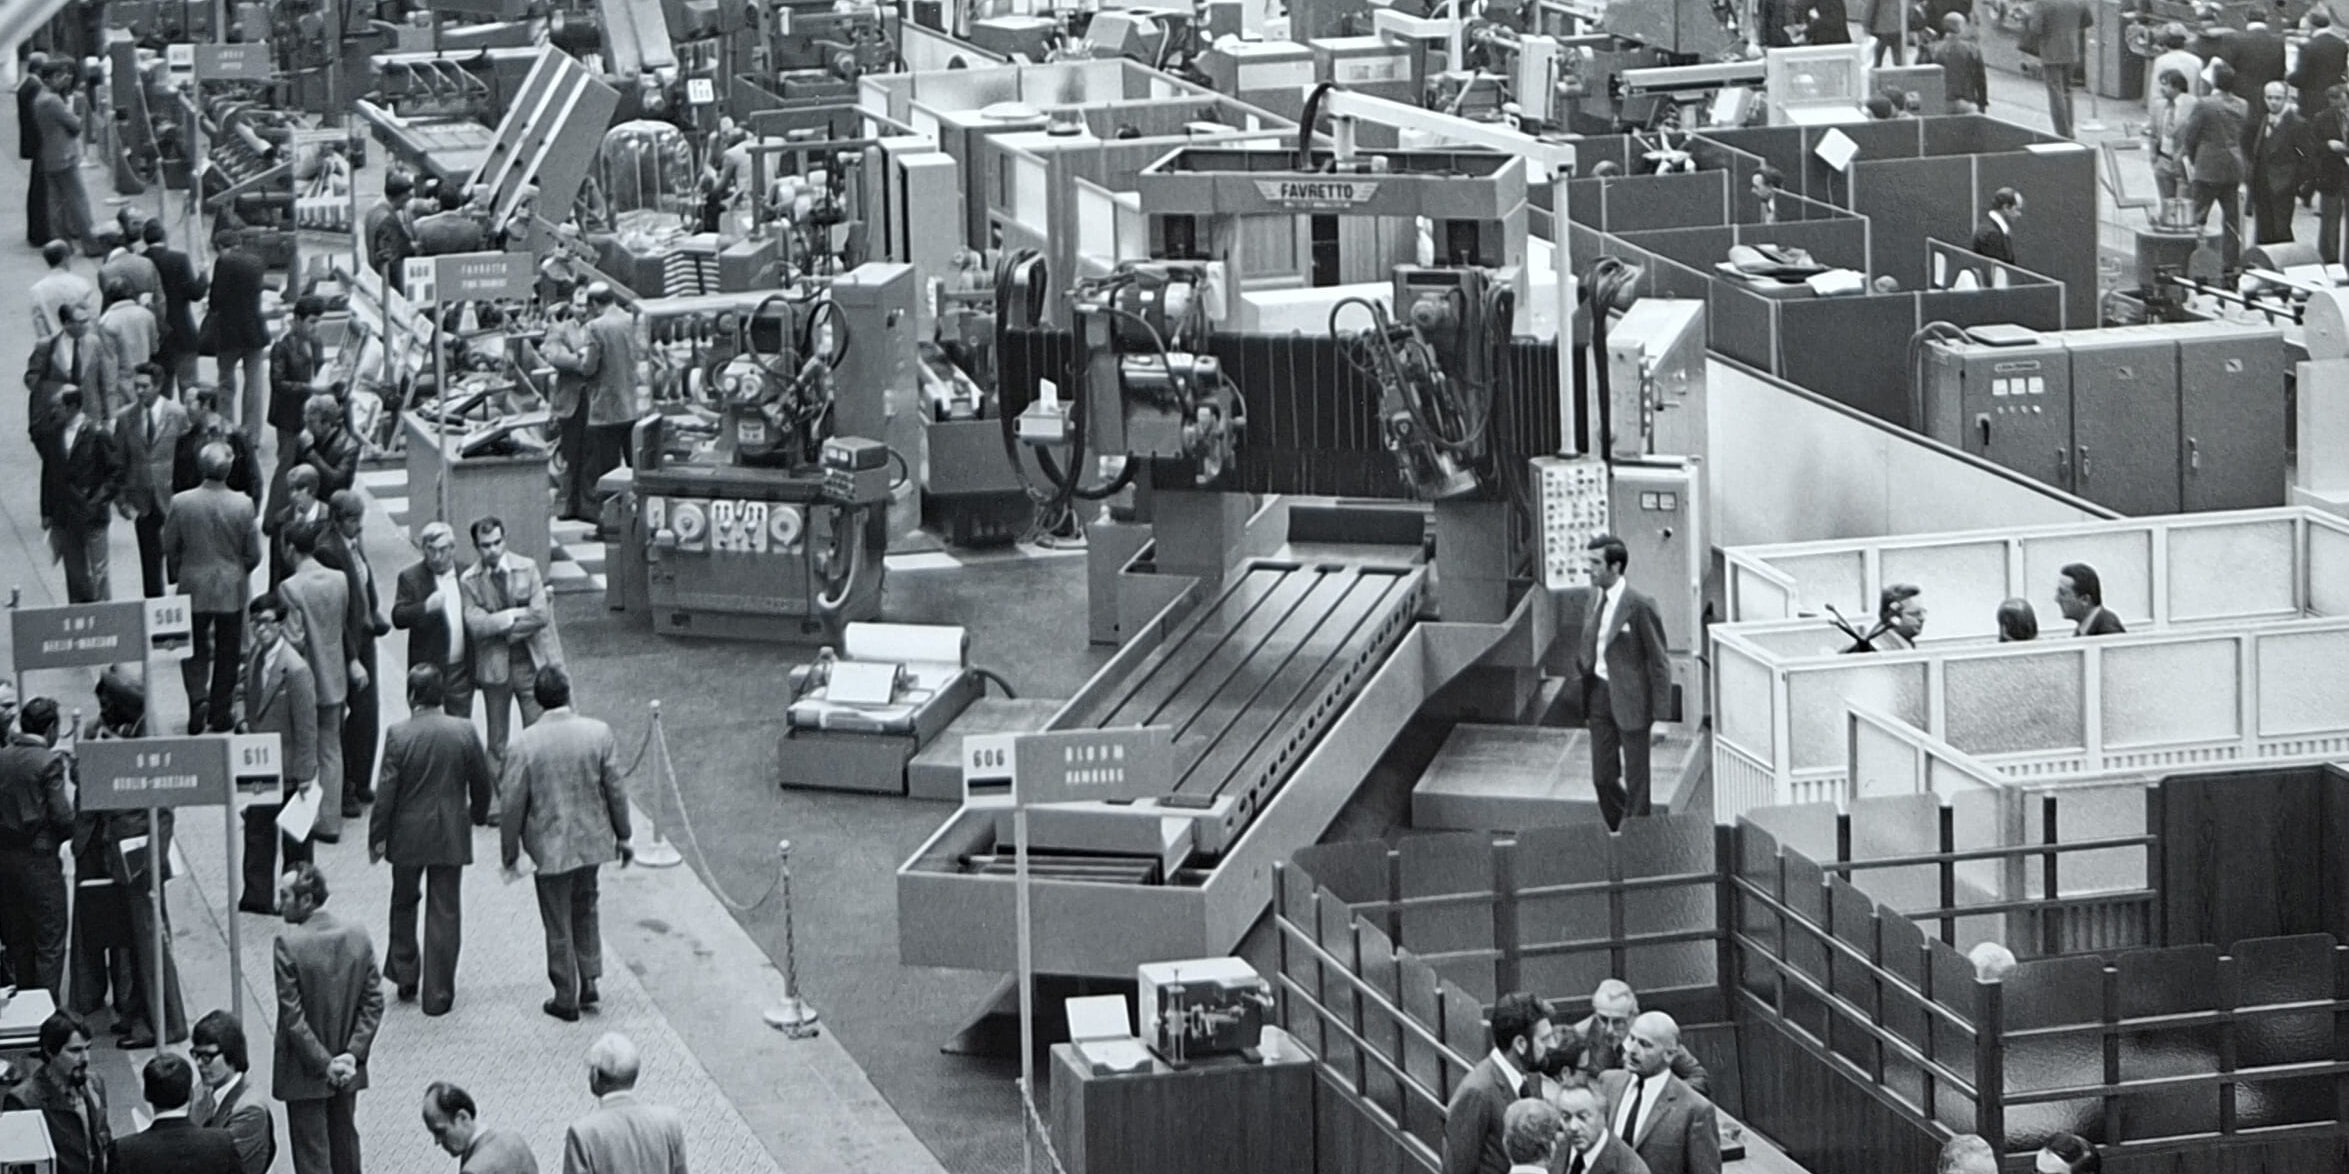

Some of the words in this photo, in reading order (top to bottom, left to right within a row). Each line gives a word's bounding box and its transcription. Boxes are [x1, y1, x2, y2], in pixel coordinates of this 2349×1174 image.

[1281, 183, 1353, 199] FAVRETTO
[243, 747, 269, 766] 611
[973, 747, 1005, 768] 606
